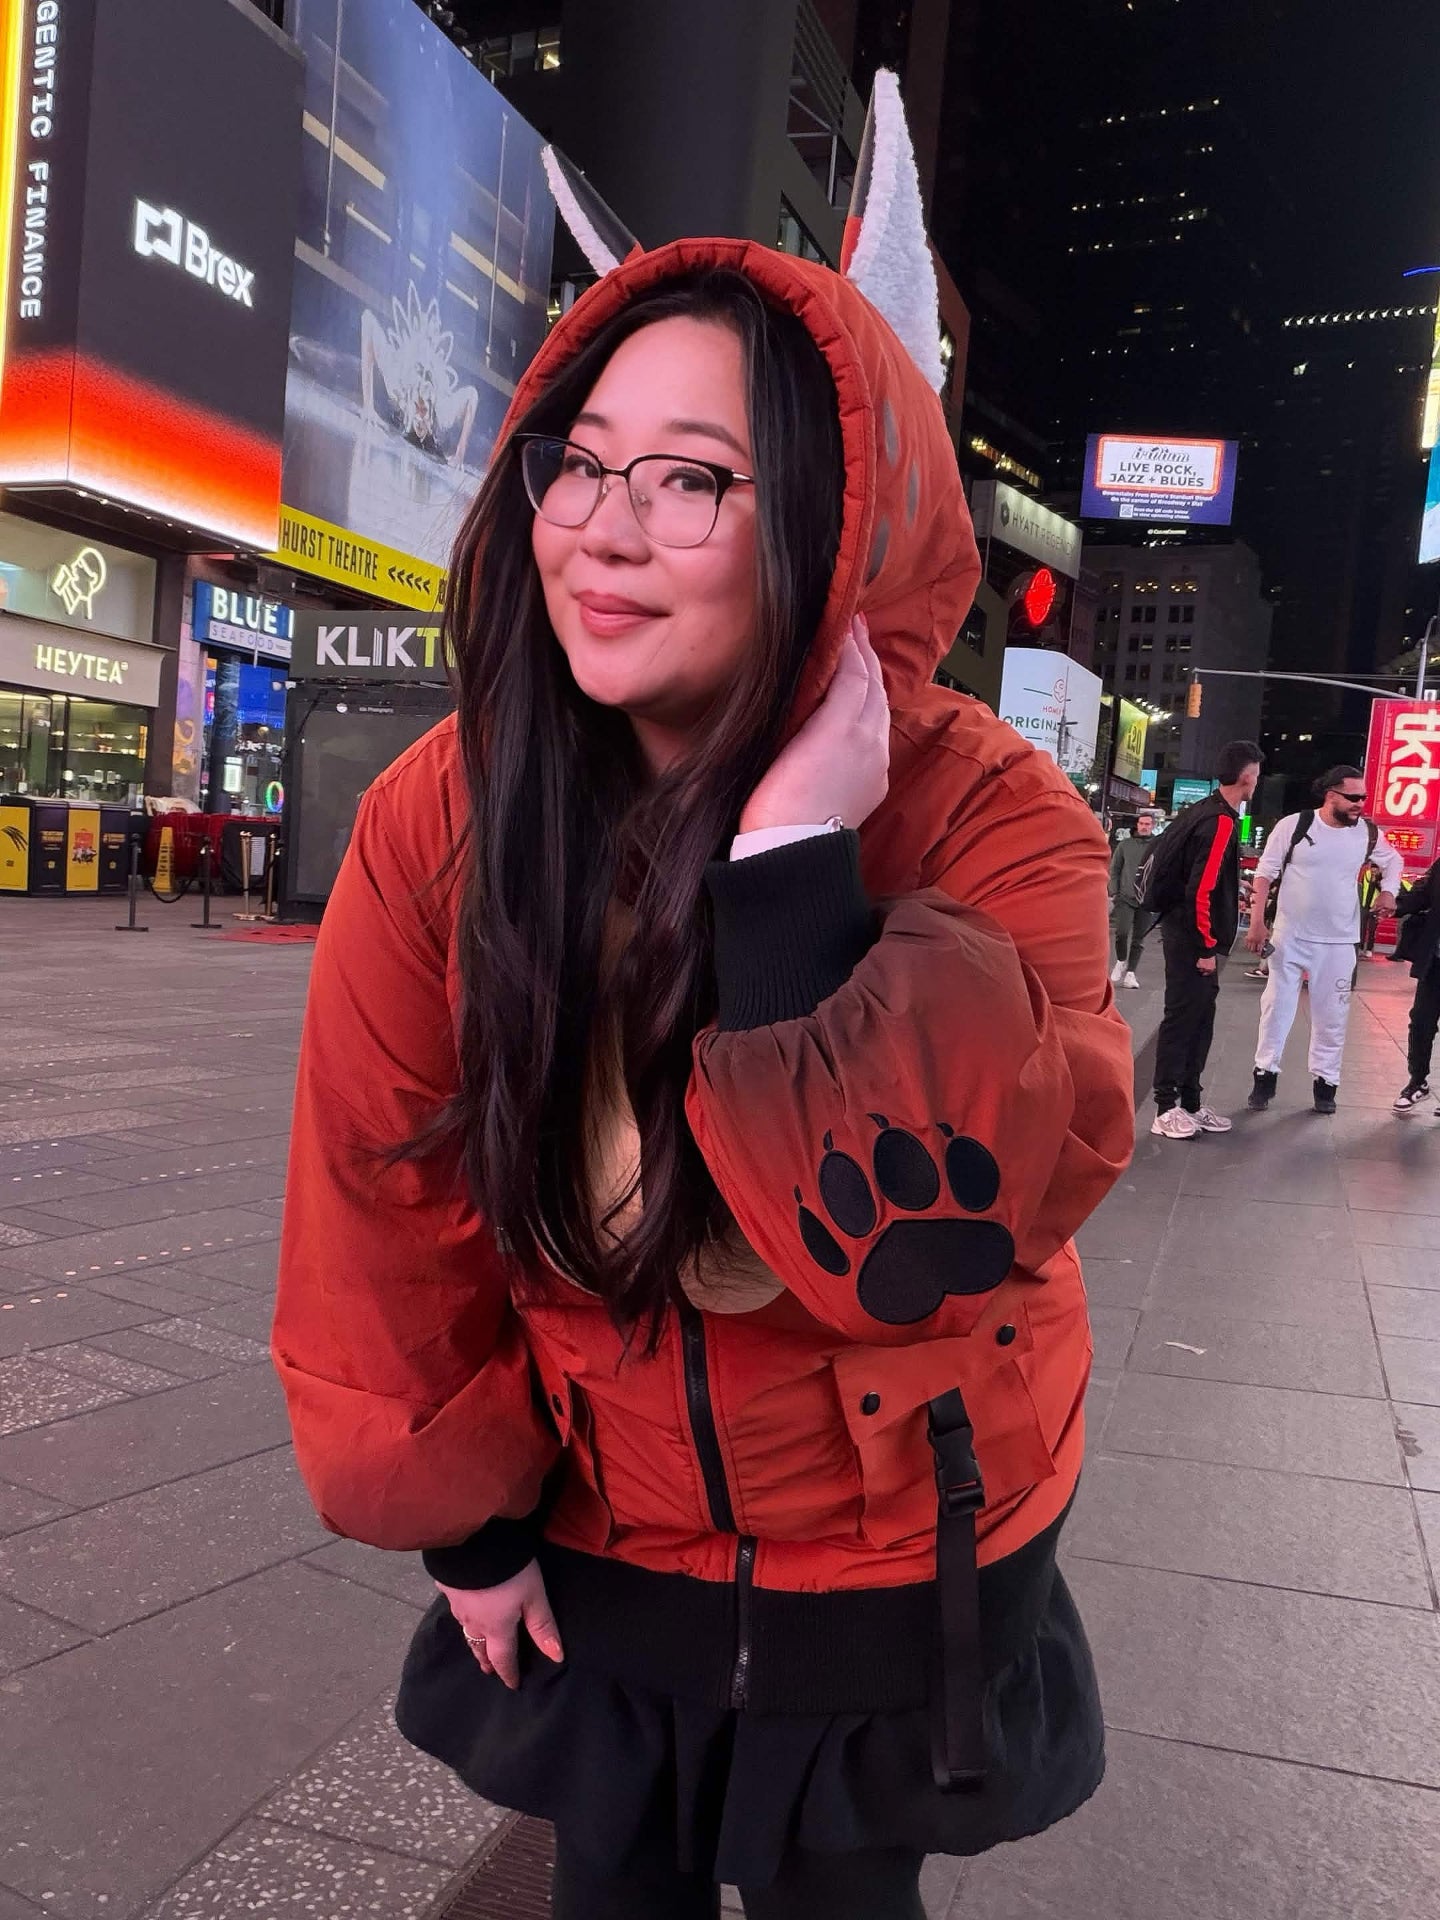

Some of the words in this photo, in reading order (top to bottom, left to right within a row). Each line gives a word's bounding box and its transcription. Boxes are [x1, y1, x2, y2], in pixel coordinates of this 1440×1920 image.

[31, 0, 59, 139] GENTIC
[20, 160, 49, 319] FINANCE
[185, 220, 255, 307] Brex
[1109, 473, 1145, 484] JAZZ
[1160, 475, 1204, 487] BLUES
[1120, 461, 1149, 473] LIVE
[1154, 463, 1197, 476] ROCK,
[1012, 511, 1039, 538] HYATT
[328, 536, 379, 581] THEATRE
[213, 586, 278, 634] BLUE
[212, 624, 274, 650] SEAFOOD
[1385, 709, 1440, 817] tkts
